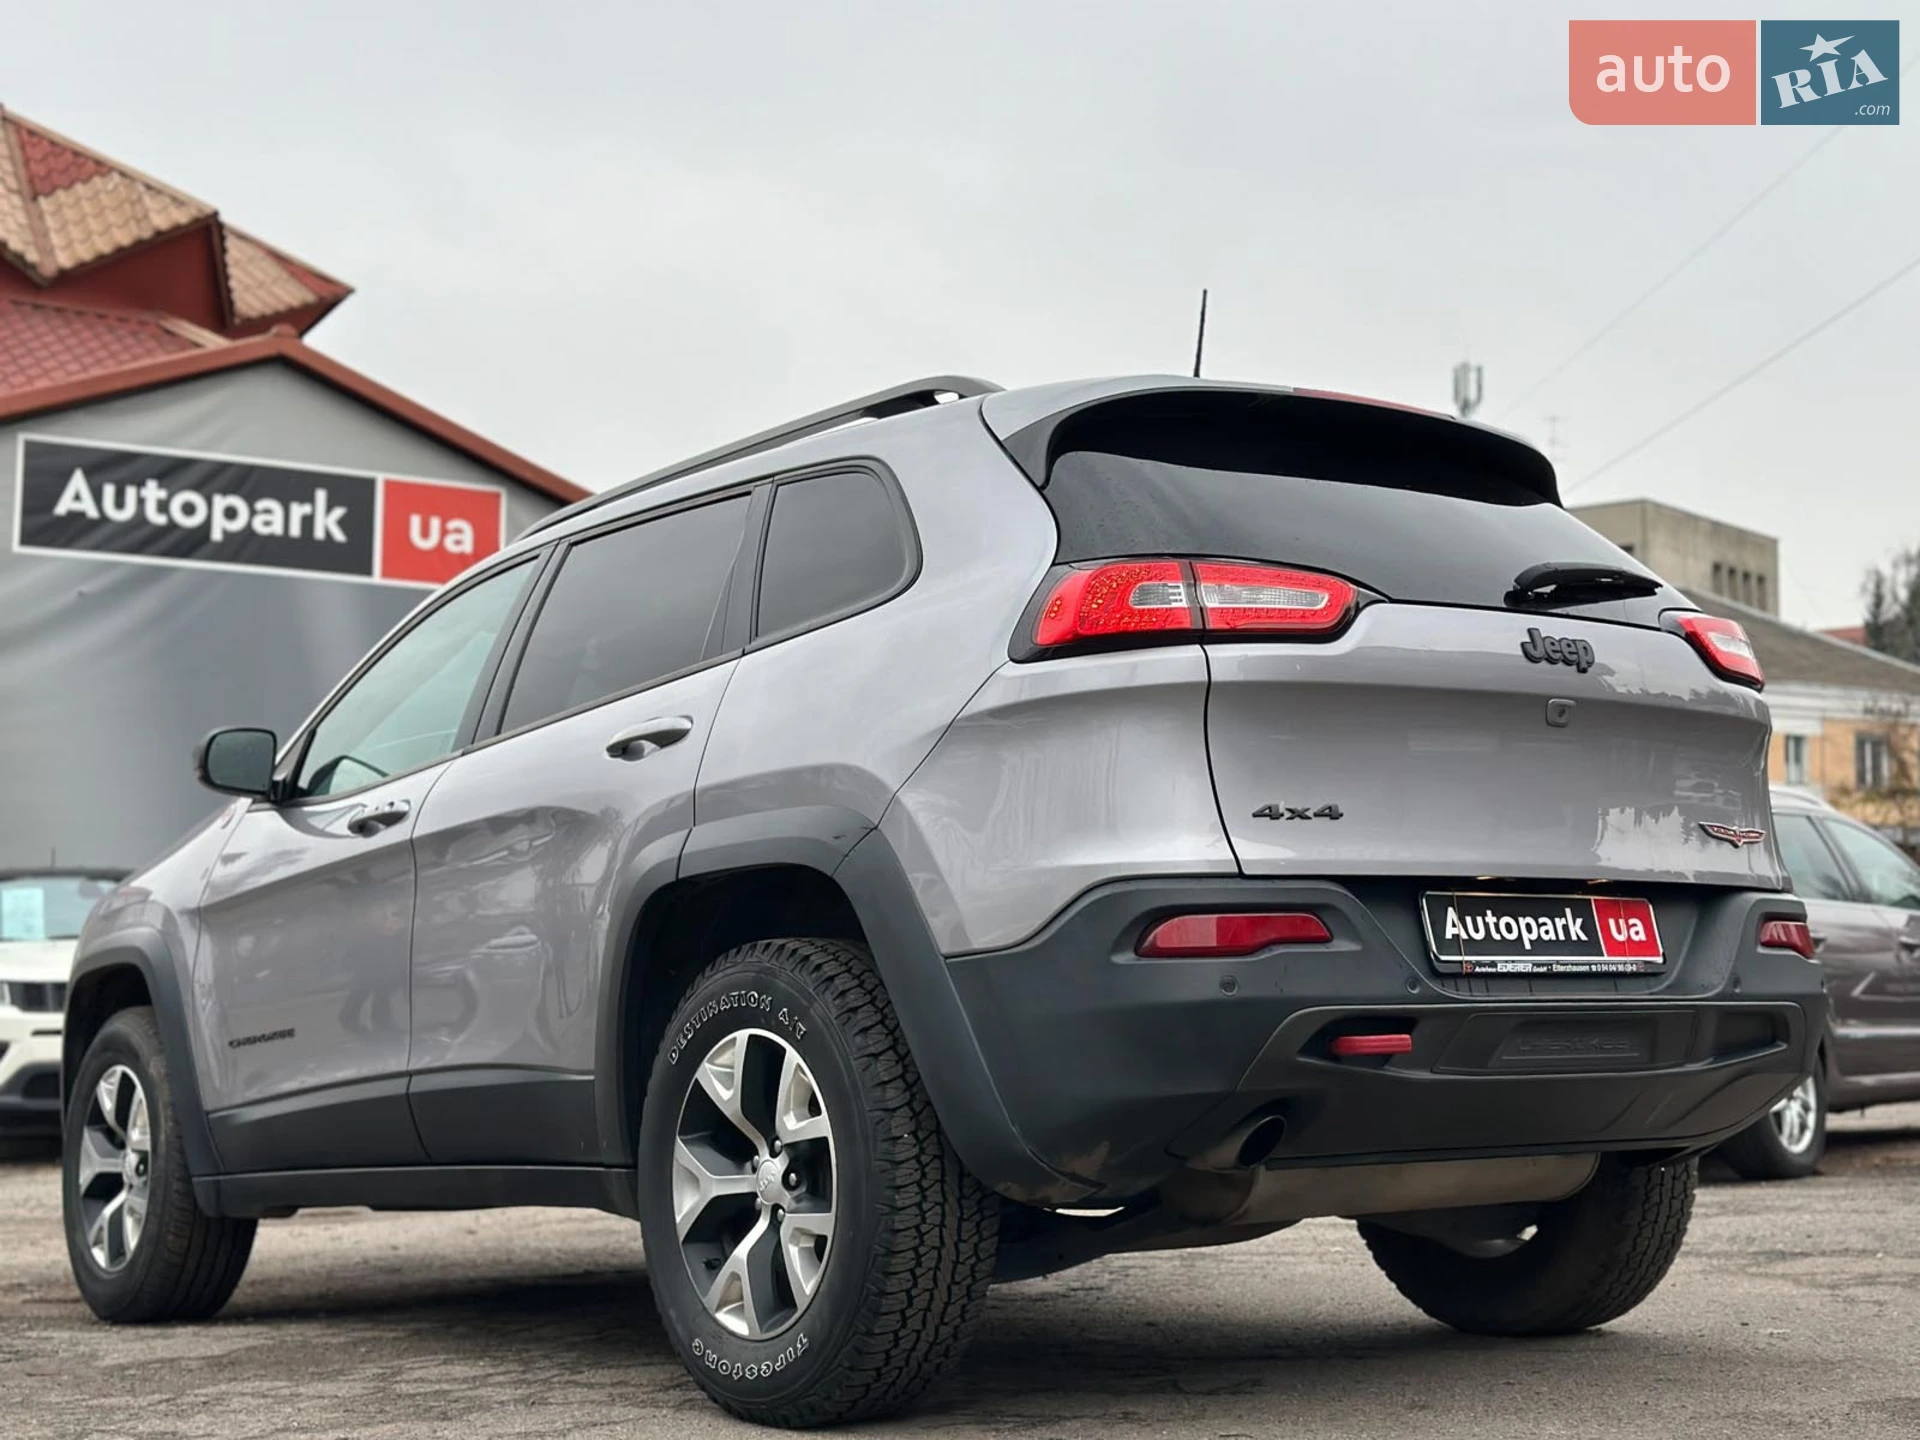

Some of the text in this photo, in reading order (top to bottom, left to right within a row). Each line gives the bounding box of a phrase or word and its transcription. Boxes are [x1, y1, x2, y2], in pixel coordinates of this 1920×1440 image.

[53, 467, 475, 554] Autopark ua
[1520, 627, 1595, 674] Jeep
[1252, 804, 1344, 821] 4x4
[1445, 906, 1647, 950] Autopark ua
[668, 990, 773, 1065] DESTINATION
